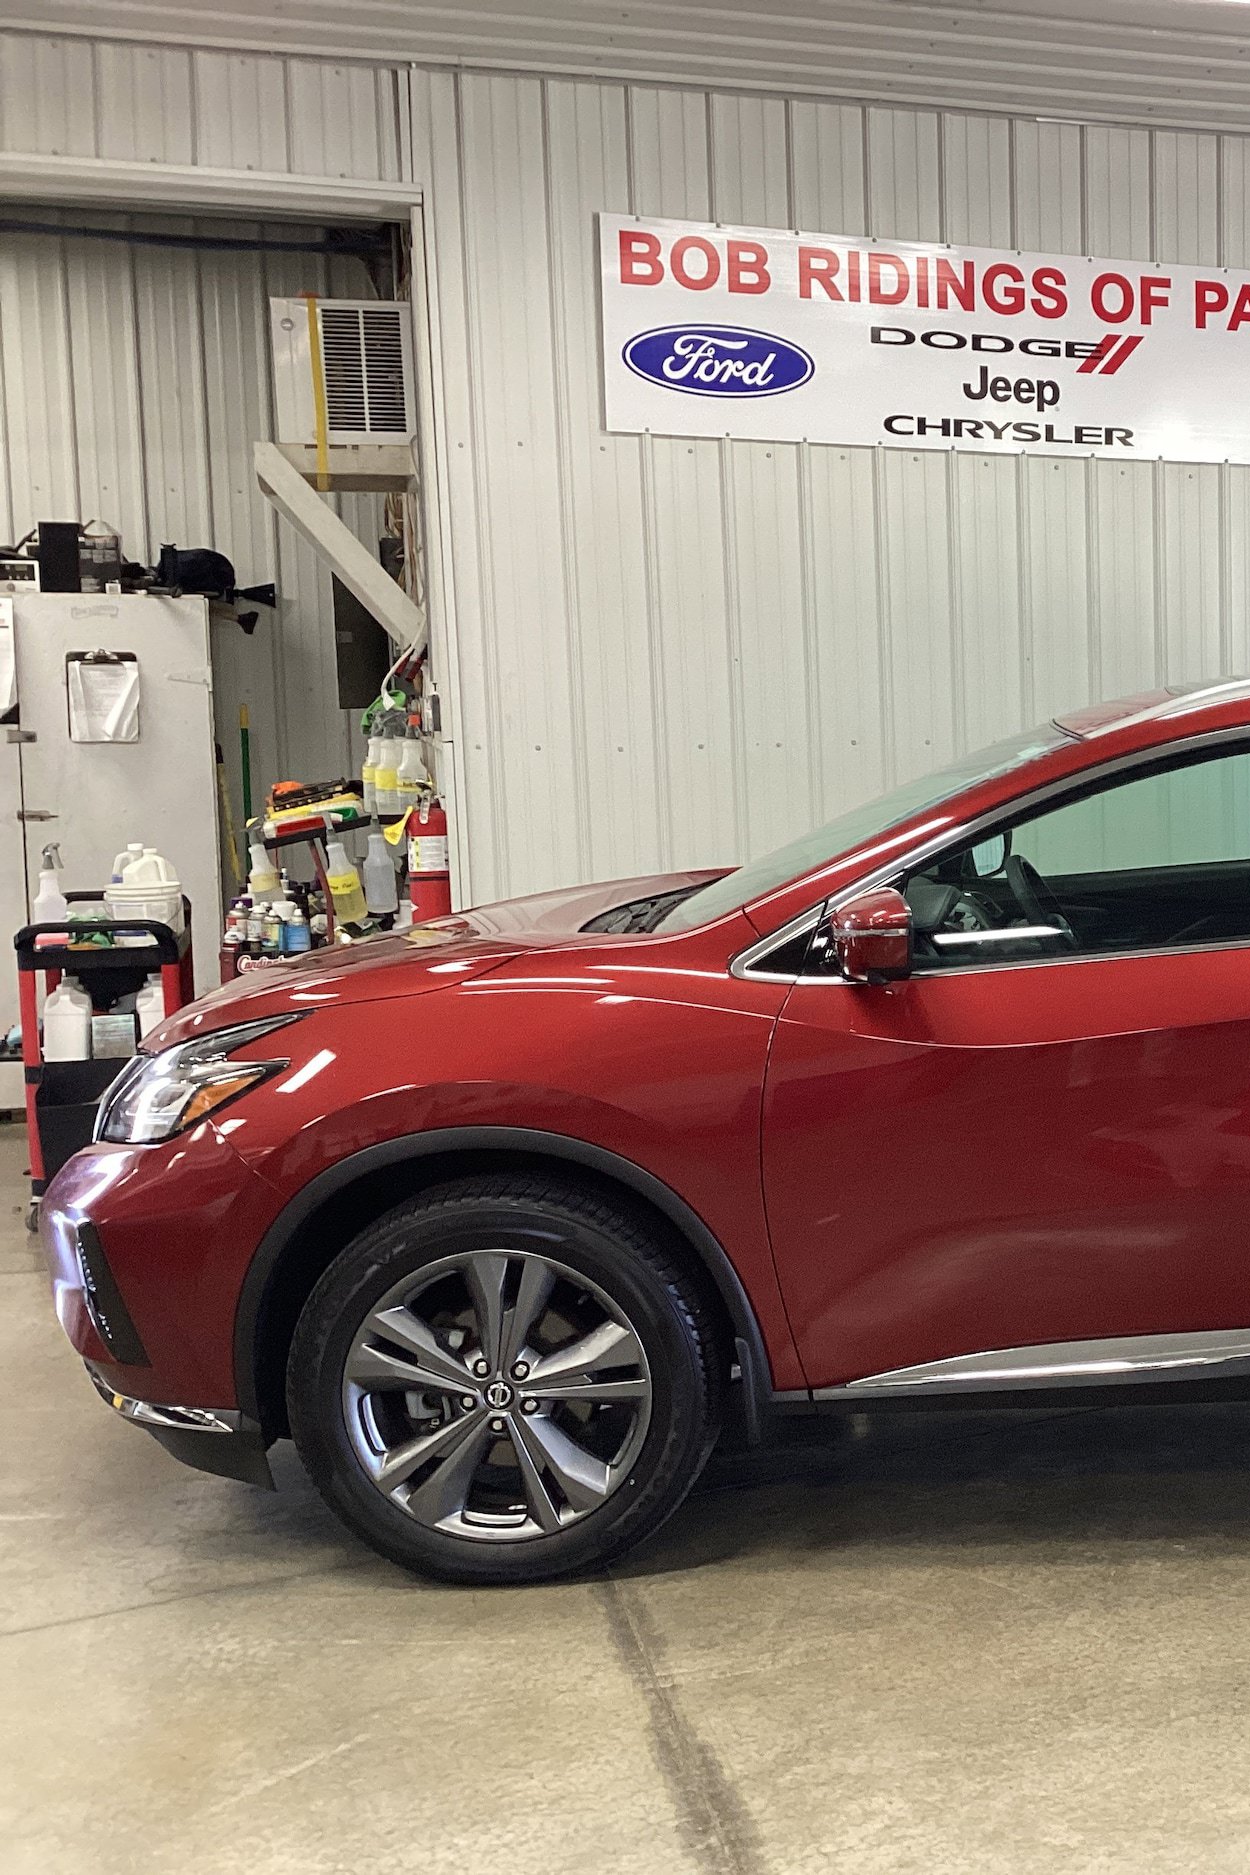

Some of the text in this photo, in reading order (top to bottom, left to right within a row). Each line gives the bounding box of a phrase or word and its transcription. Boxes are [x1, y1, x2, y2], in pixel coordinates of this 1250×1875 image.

[619, 230, 771, 294] BOB
[799, 247, 1068, 319] RIDINGS
[1091, 273, 1171, 326] OF
[661, 334, 777, 387] Ford
[870, 326, 1104, 361] DODGE
[962, 365, 1061, 412] Jeep
[883, 415, 1134, 447] CHRYSLER
